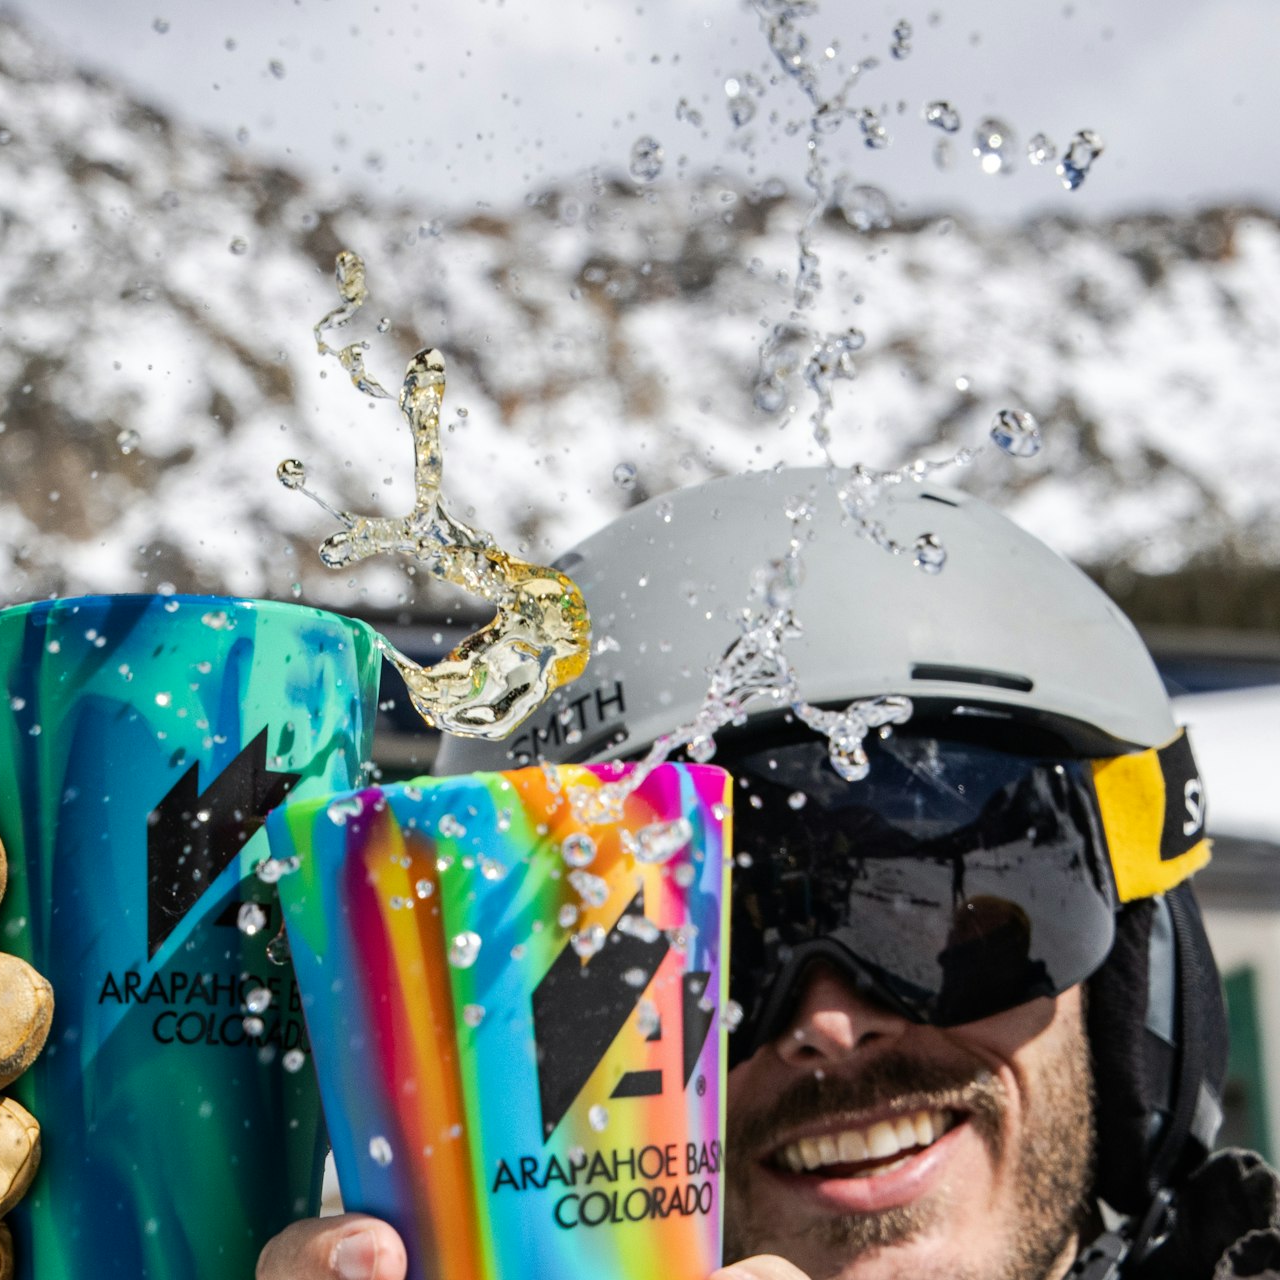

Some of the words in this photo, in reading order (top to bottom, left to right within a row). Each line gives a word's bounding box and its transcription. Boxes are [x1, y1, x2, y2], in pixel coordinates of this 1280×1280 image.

[509, 680, 626, 759] SMITH
[98, 971, 282, 1011] ARAPAHOE
[492, 1144, 678, 1193] ARAPAHOE
[553, 1181, 713, 1229] COLORADO
